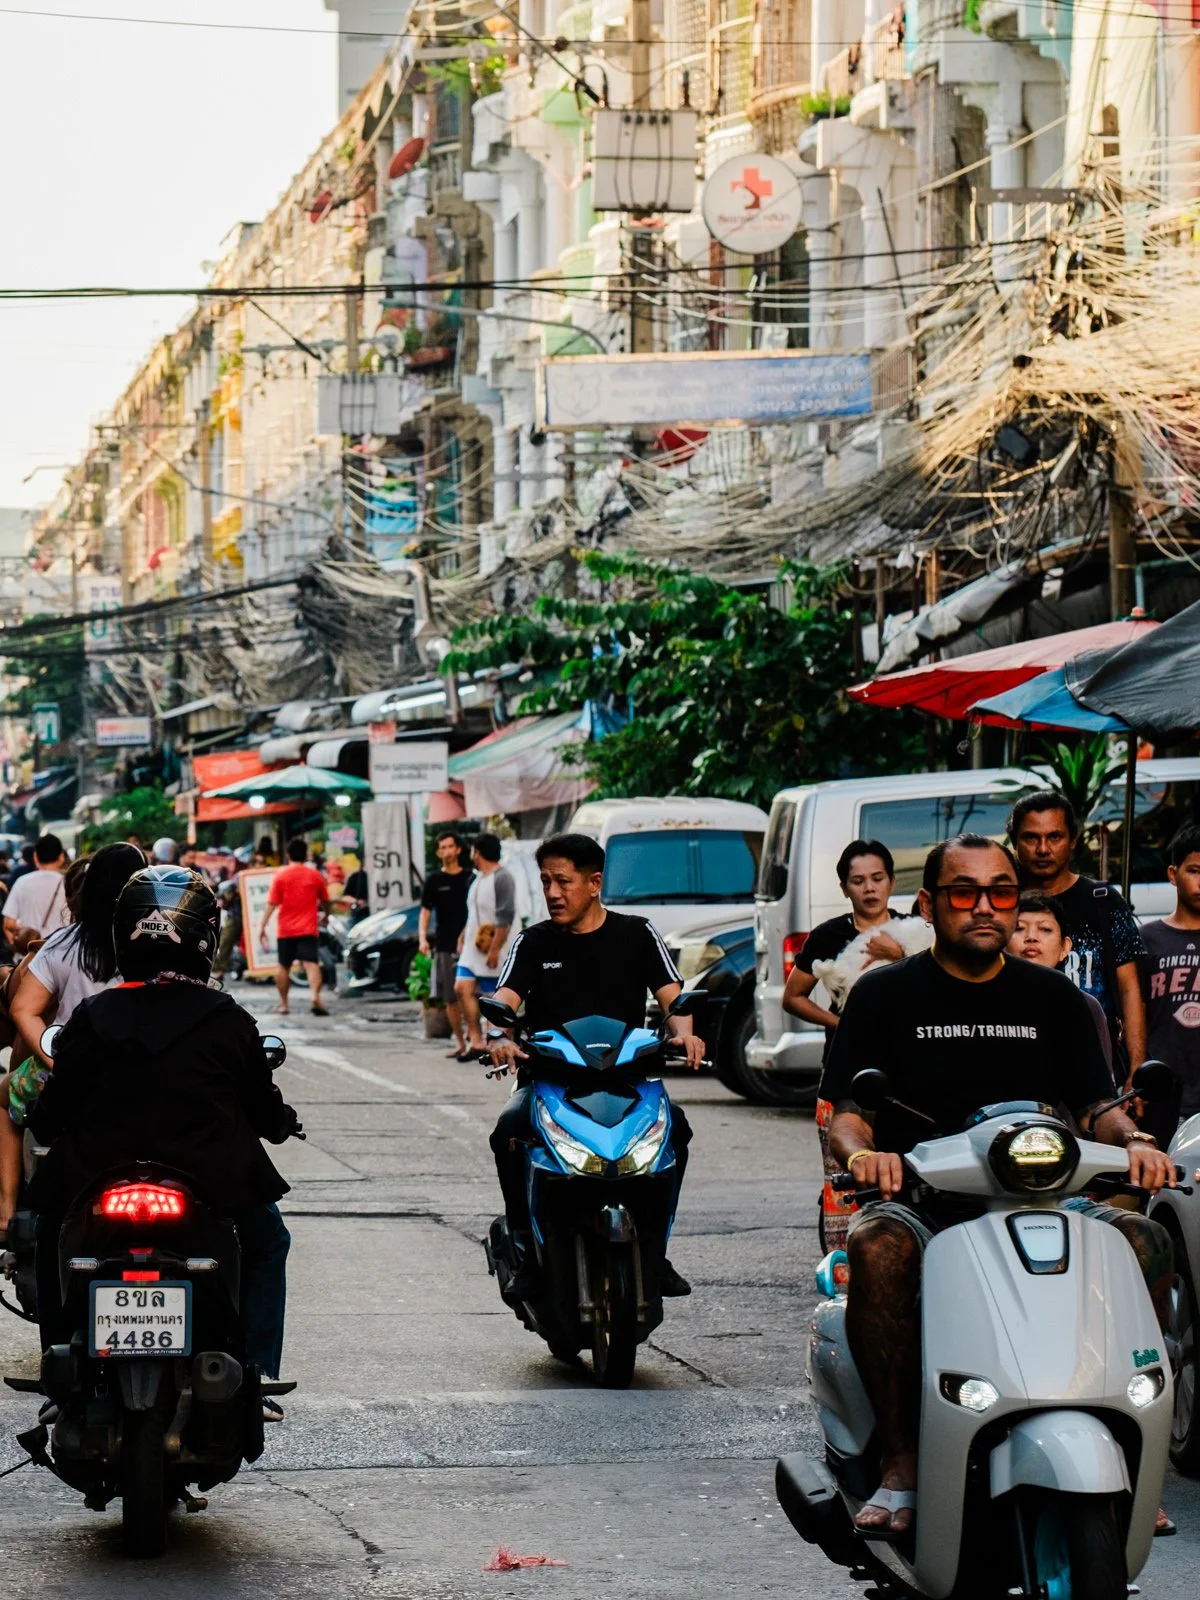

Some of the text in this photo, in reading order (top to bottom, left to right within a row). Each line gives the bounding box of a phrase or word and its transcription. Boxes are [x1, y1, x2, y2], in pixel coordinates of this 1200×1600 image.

[373, 846, 401, 869] รัก
[376, 880, 404, 899] ษา
[141, 921, 169, 932] INDEX
[916, 1025, 1037, 1039] STRONG/TRAINING
[115, 1289, 165, 1308] 8ขล
[97, 1314, 183, 1328] กรุงเทพมหานคร
[105, 1330, 173, 1348] 4486
